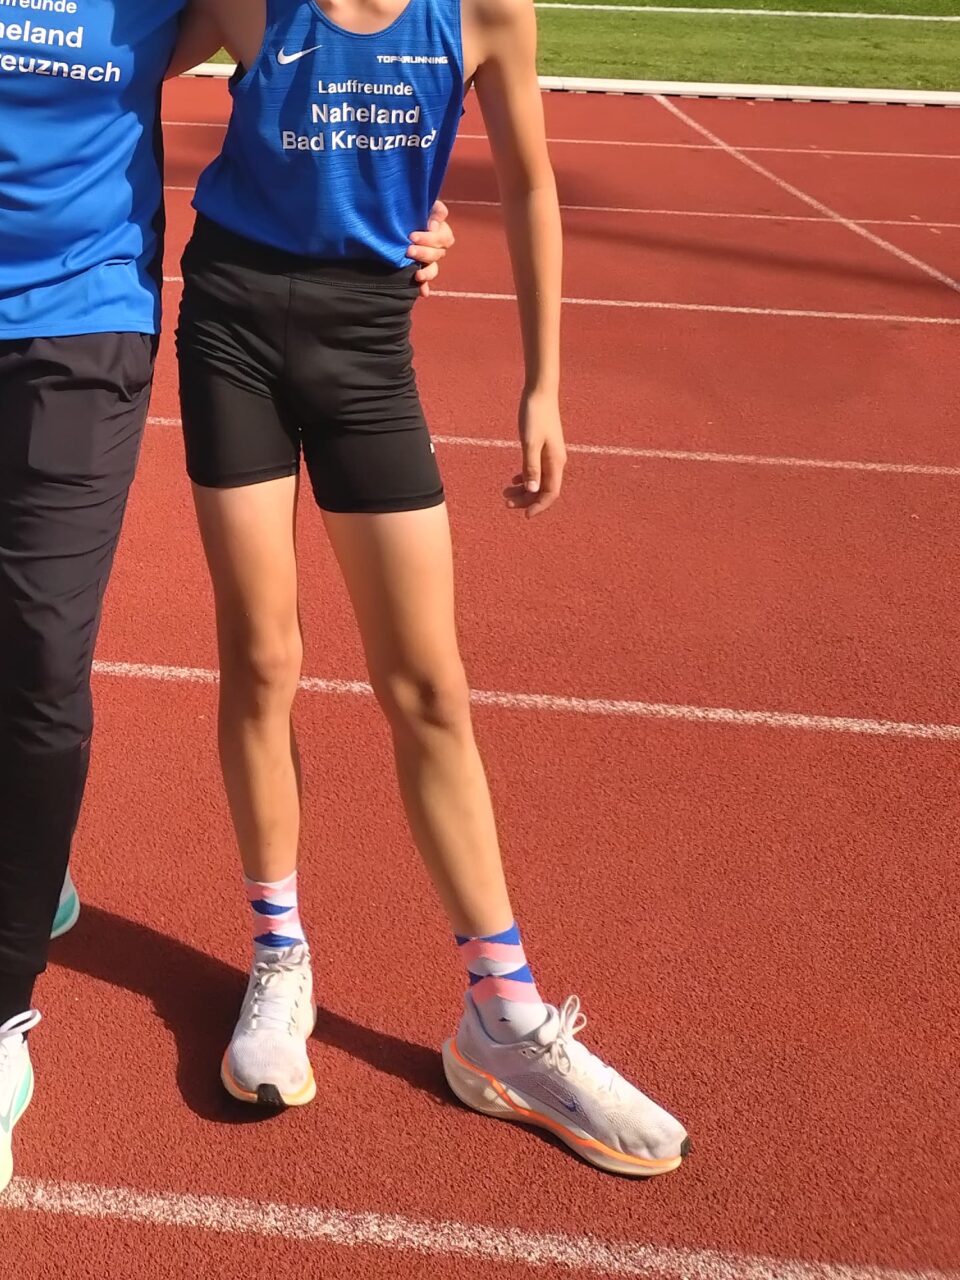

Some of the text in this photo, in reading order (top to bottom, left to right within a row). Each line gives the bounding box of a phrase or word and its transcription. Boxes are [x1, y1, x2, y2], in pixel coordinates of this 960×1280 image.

[318, 80, 414, 96] Lauffreunde
[312, 103, 420, 124] Naheland
[283, 131, 324, 151] Bad
